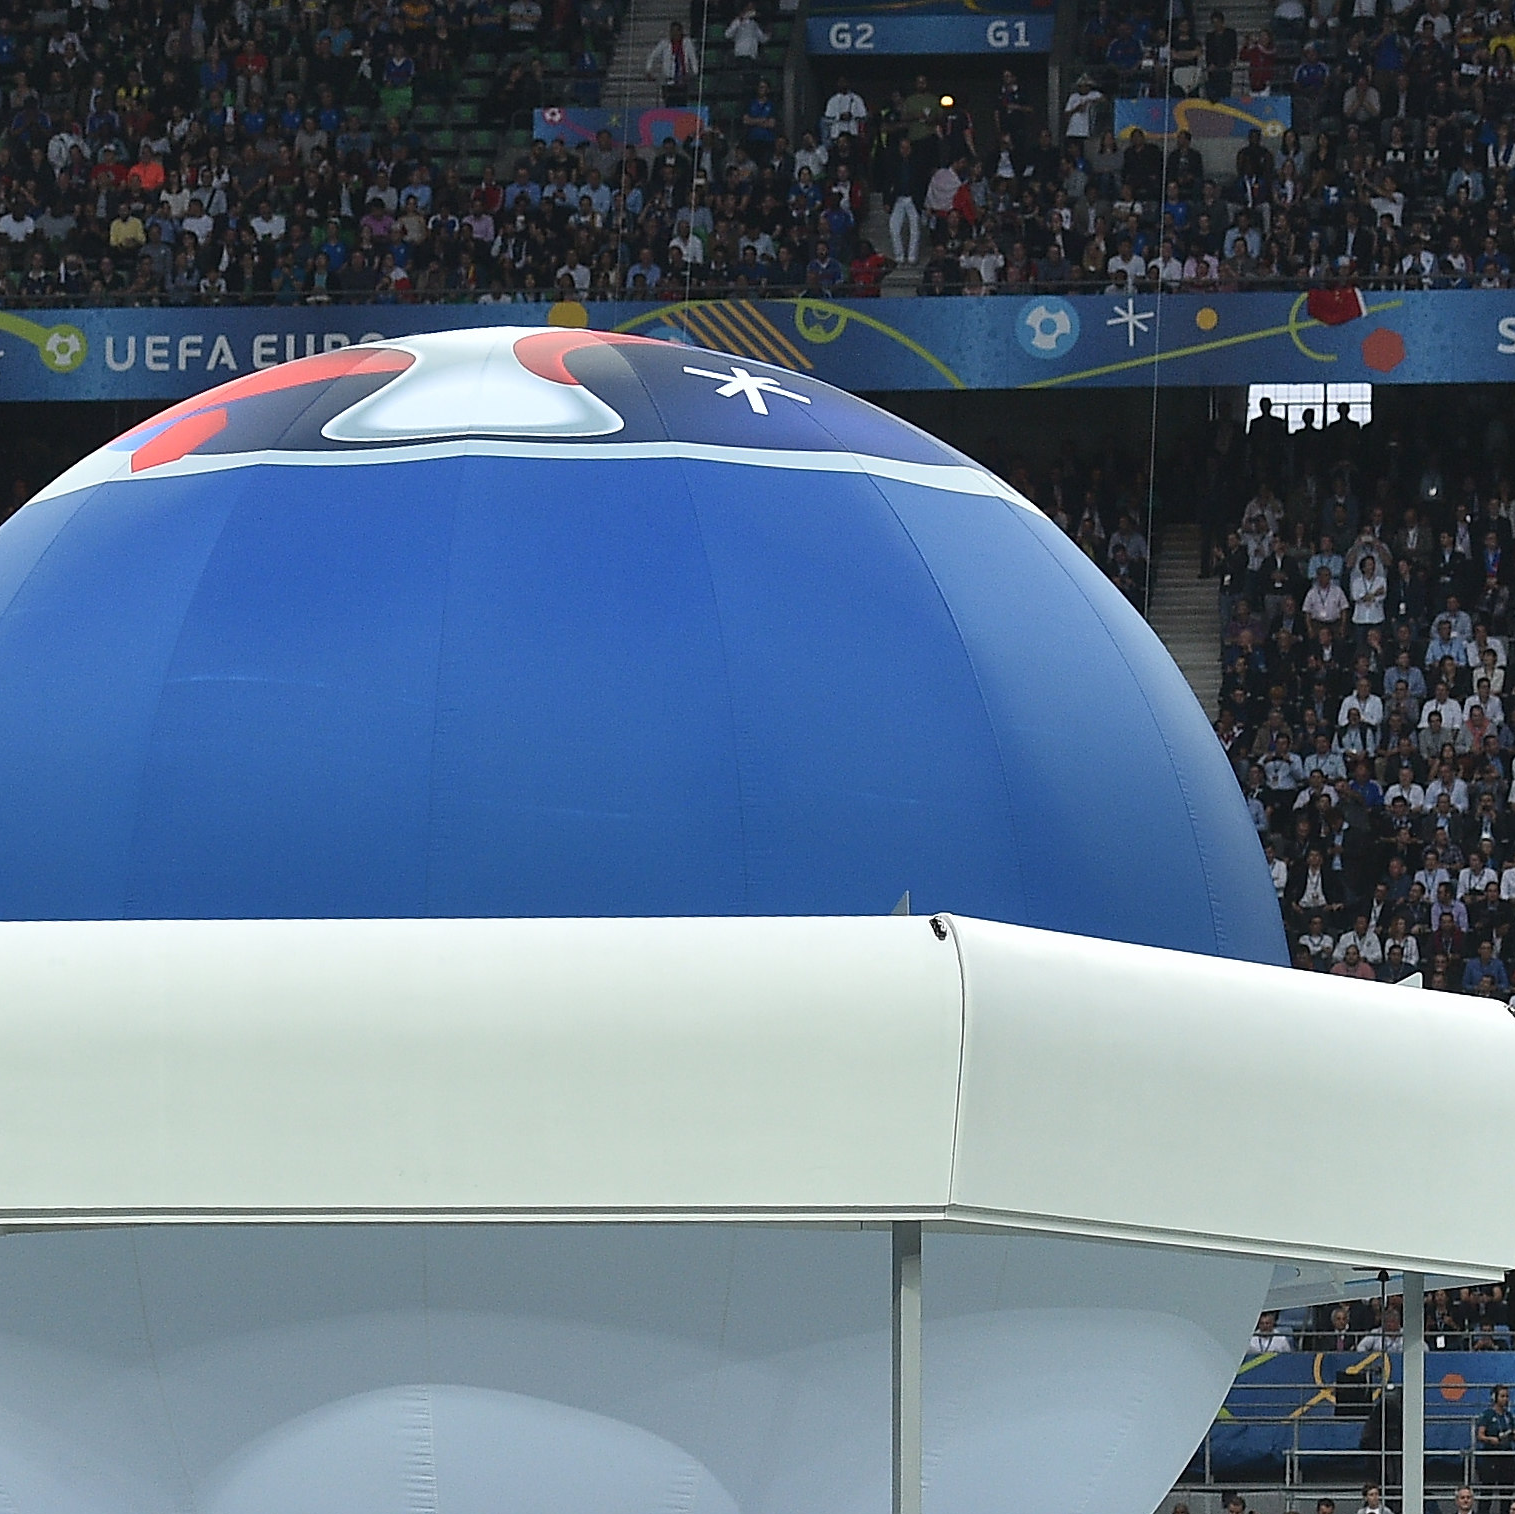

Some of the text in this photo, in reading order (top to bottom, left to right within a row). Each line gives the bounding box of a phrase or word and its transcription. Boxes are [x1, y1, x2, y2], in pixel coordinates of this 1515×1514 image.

[829, 22, 874, 50] G2
[986, 20, 1030, 48] G1
[105, 335, 238, 372] UEFA
